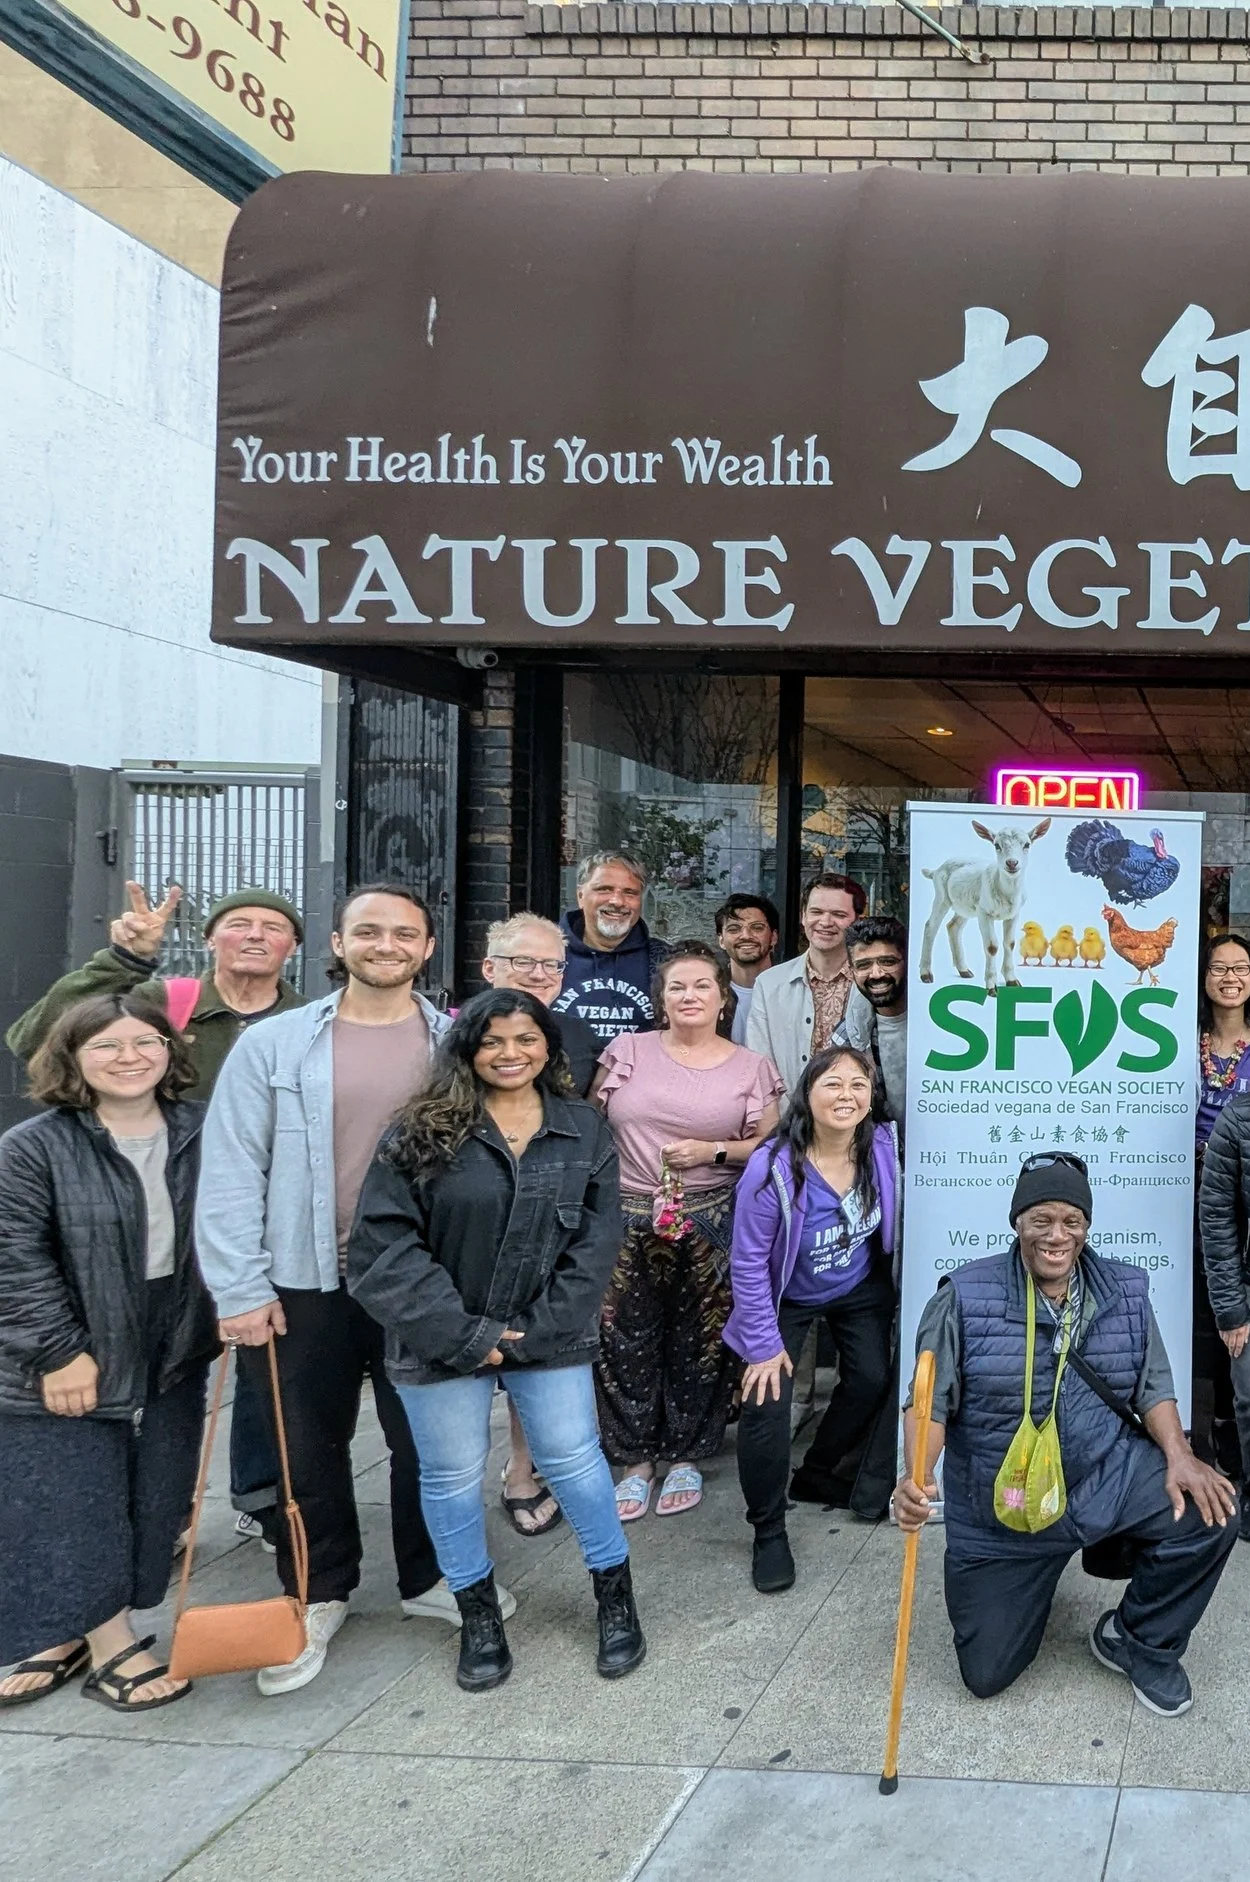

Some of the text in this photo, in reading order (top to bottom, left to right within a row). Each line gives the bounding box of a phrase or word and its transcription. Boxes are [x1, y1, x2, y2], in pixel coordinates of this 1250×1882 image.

[232, 433, 833, 486] Your Health Is Your Wealth
[226, 534, 795, 632] NATURE
[1006, 776, 1130, 810] OPEN
[576, 1005, 634, 1020] VEGAN
[590, 1024, 640, 1037] CIETY
[921, 1080, 1185, 1095] SAN FRANCISCO VEGAN SOCIETY
[917, 1099, 1189, 1116] Sociedad vegana de San Francisco
[988, 1124, 1130, 1144] 舊金山素食協會
[920, 1150, 946, 1166] Hội
[1110, 1151, 1187, 1164] Francisco
[914, 1174, 992, 1187] Веганское
[1087, 1173, 1191, 1189] ан-Франциско
[815, 1231, 821, 1247] I
[948, 1230, 980, 1246] We
[1086, 1230, 1162, 1248] eganism,
[813, 1262, 831, 1275] FOR
